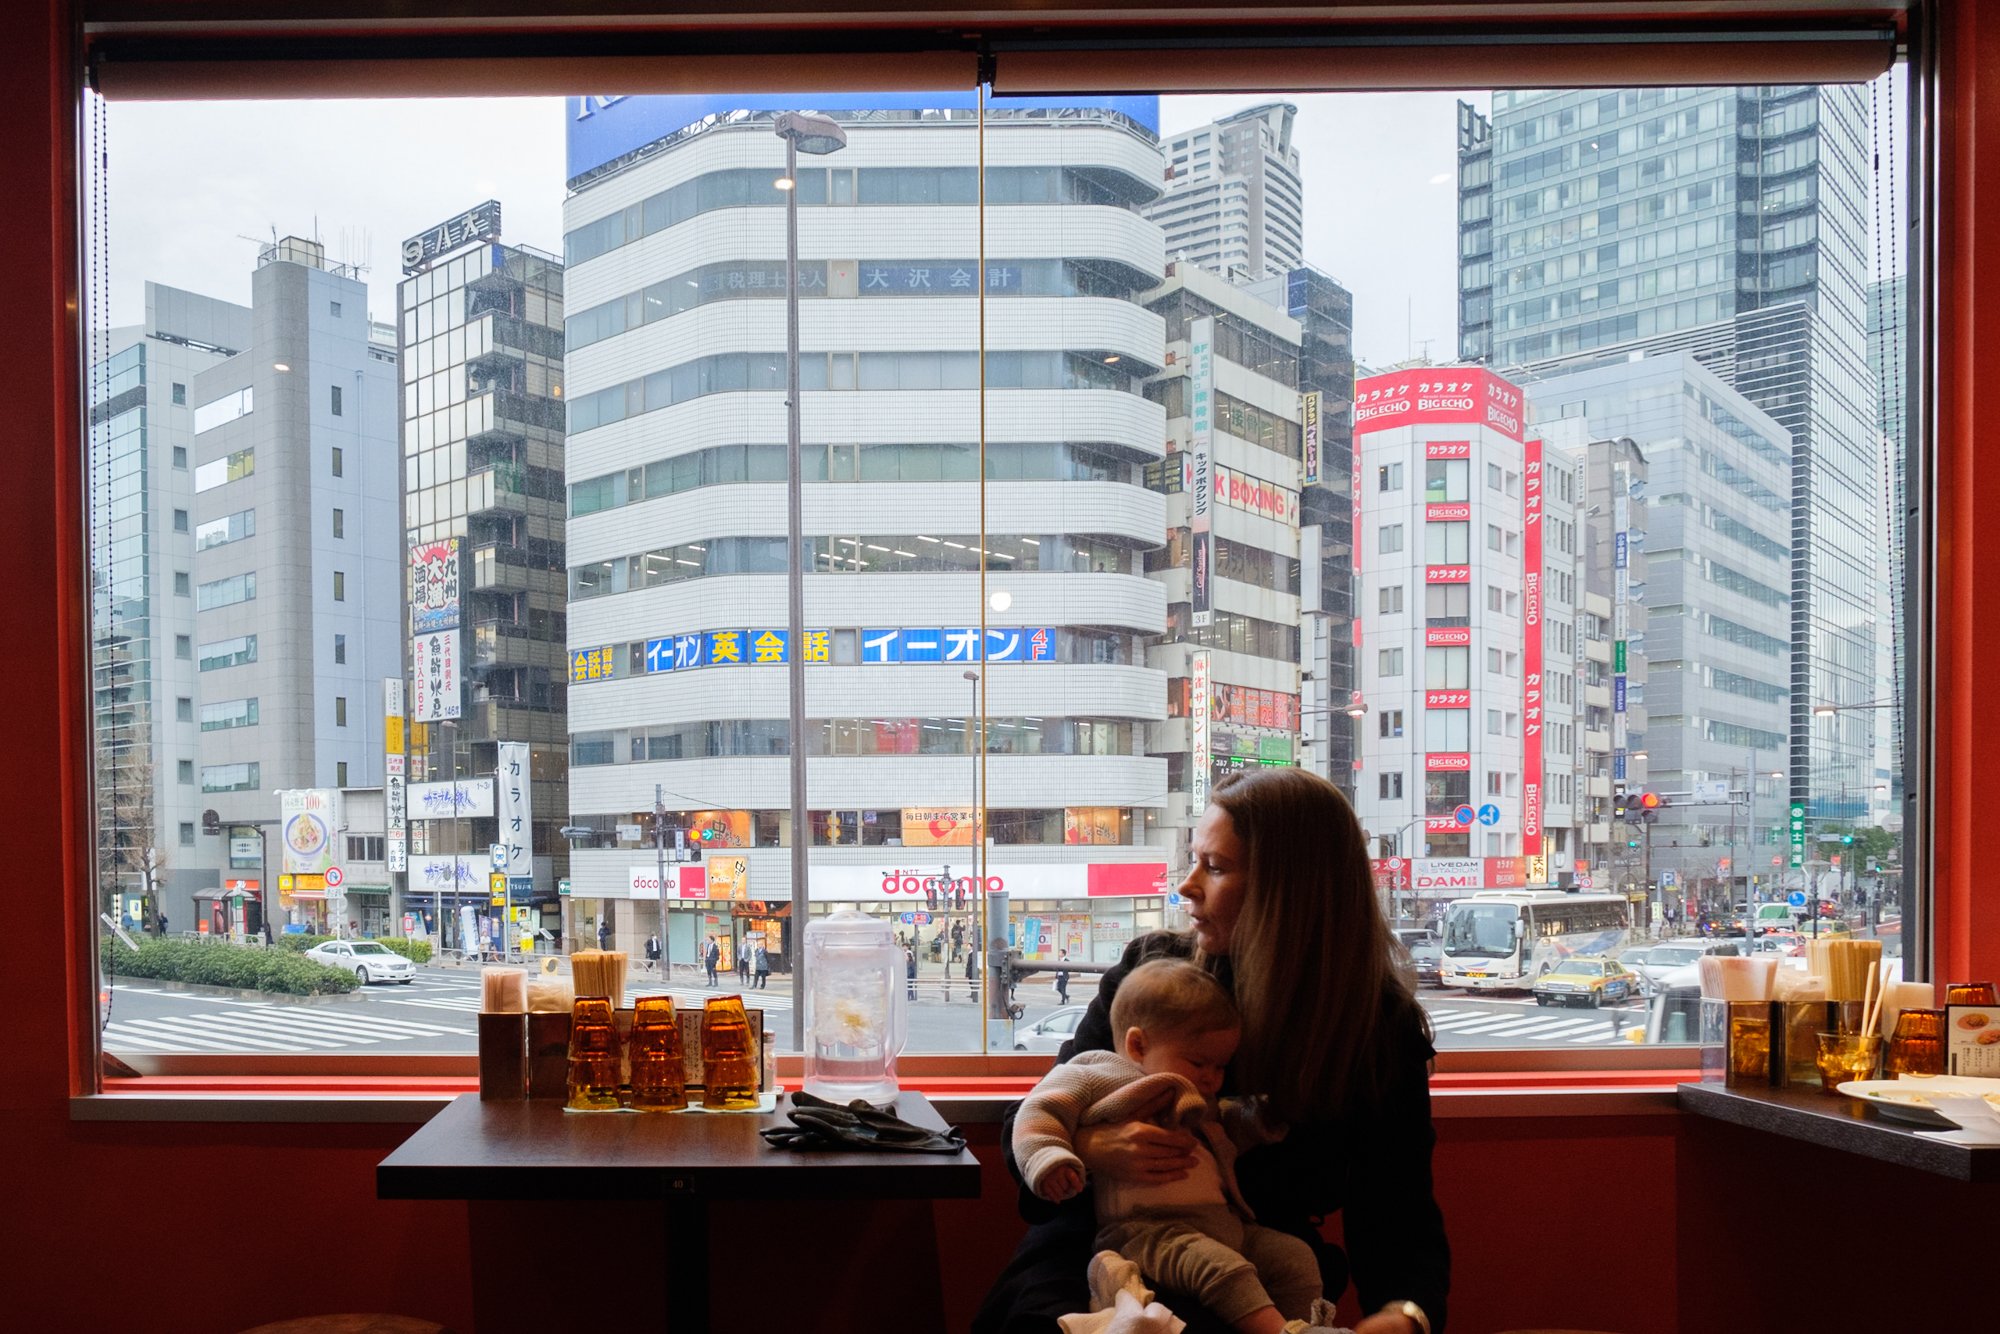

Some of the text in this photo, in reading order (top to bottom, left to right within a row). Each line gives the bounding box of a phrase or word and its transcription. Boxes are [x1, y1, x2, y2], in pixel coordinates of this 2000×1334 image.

[866, 267, 1011, 288] 大沢会計
[1357, 384, 1410, 404] カラオケ
[1419, 382, 1473, 393] カラオケ
[1488, 383, 1517, 408] カラオケ
[1356, 400, 1411, 421] BIG ECHO
[1418, 398, 1474, 411] BIG ECHO
[1428, 445, 1468, 455] カラオケ
[1195, 452, 1208, 516] キックボクシング
[1526, 461, 1541, 525] カラオケ
[1230, 479, 1284, 516] BOXING
[1428, 508, 1469, 518] BIG ECHO
[414, 564, 426, 604] 酒場
[427, 555, 445, 609] 大漁
[445, 557, 457, 599] 九州
[1428, 569, 1468, 579] カラオケ
[1526, 572, 1538, 626] BIG ECHO
[712, 631, 829, 664] 英会話
[864, 630, 1020, 662] イーオン
[1428, 632, 1469, 642] BIG ECHO
[570, 650, 601, 682] 会話
[602, 648, 613, 677] 留学
[648, 636, 701, 672] イーオン
[1428, 694, 1468, 704] カラオケ
[1526, 673, 1541, 737] カラオケ
[1428, 758, 1469, 767] BIG ECHO
[1695, 783, 1726, 793] 大門
[510, 760, 523, 860] カラオケ
[1525, 783, 1537, 836] BIG ECHO
[1428, 820, 1464, 829] カラオ
[424, 860, 478, 883] カラの鉄人
[882, 869, 1004, 895] docomo
[1417, 876, 1466, 887] DAM
[1662, 872, 1674, 885] P
